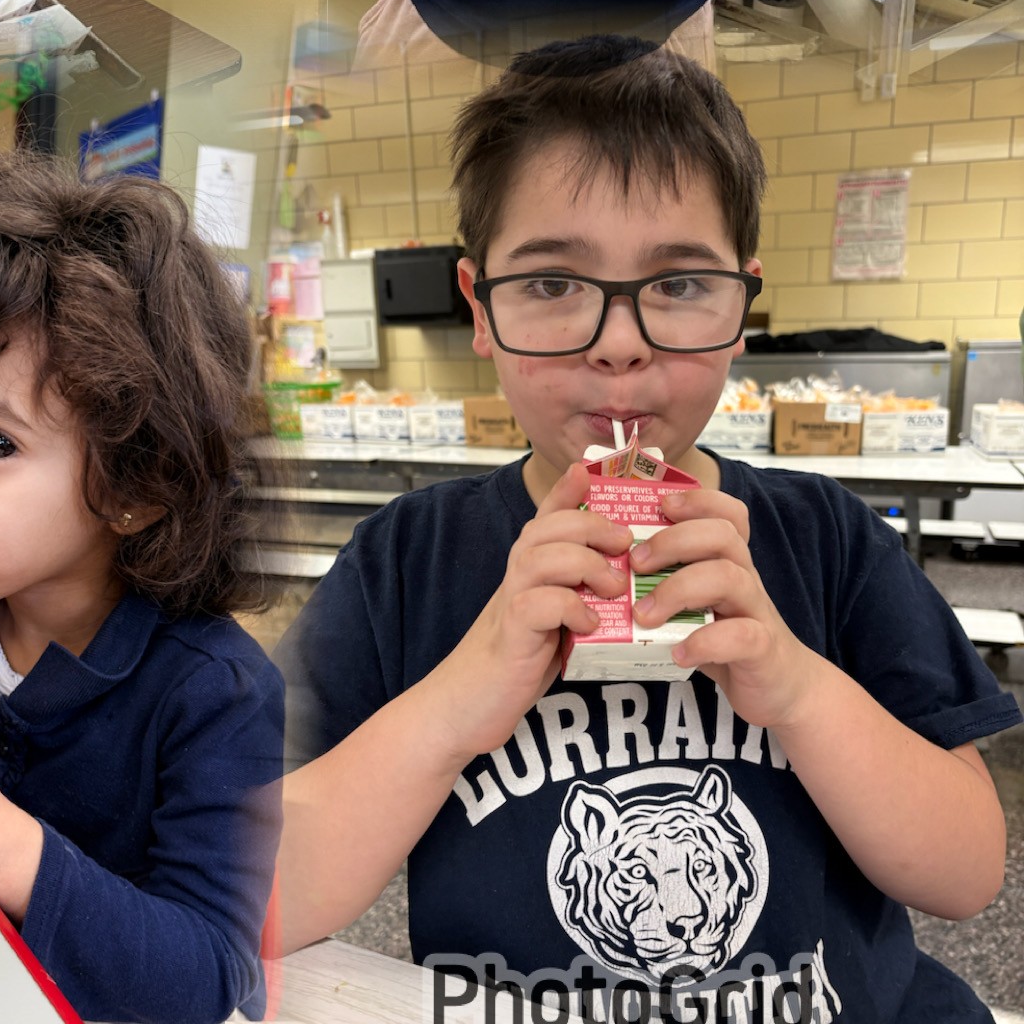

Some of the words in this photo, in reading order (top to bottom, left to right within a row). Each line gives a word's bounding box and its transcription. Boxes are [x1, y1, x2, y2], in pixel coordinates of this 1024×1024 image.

[590, 493, 618, 501] FLAVORS
[621, 494, 632, 502] OR
[634, 495, 659, 503] COLORS
[590, 504, 611, 512] GOOD
[613, 504, 640, 513] SOURCE
[642, 505, 651, 513] OF
[630, 513, 660, 522] VITAMIN
[608, 560, 622, 569] REE
[595, 603, 625, 611] NUTRITION
